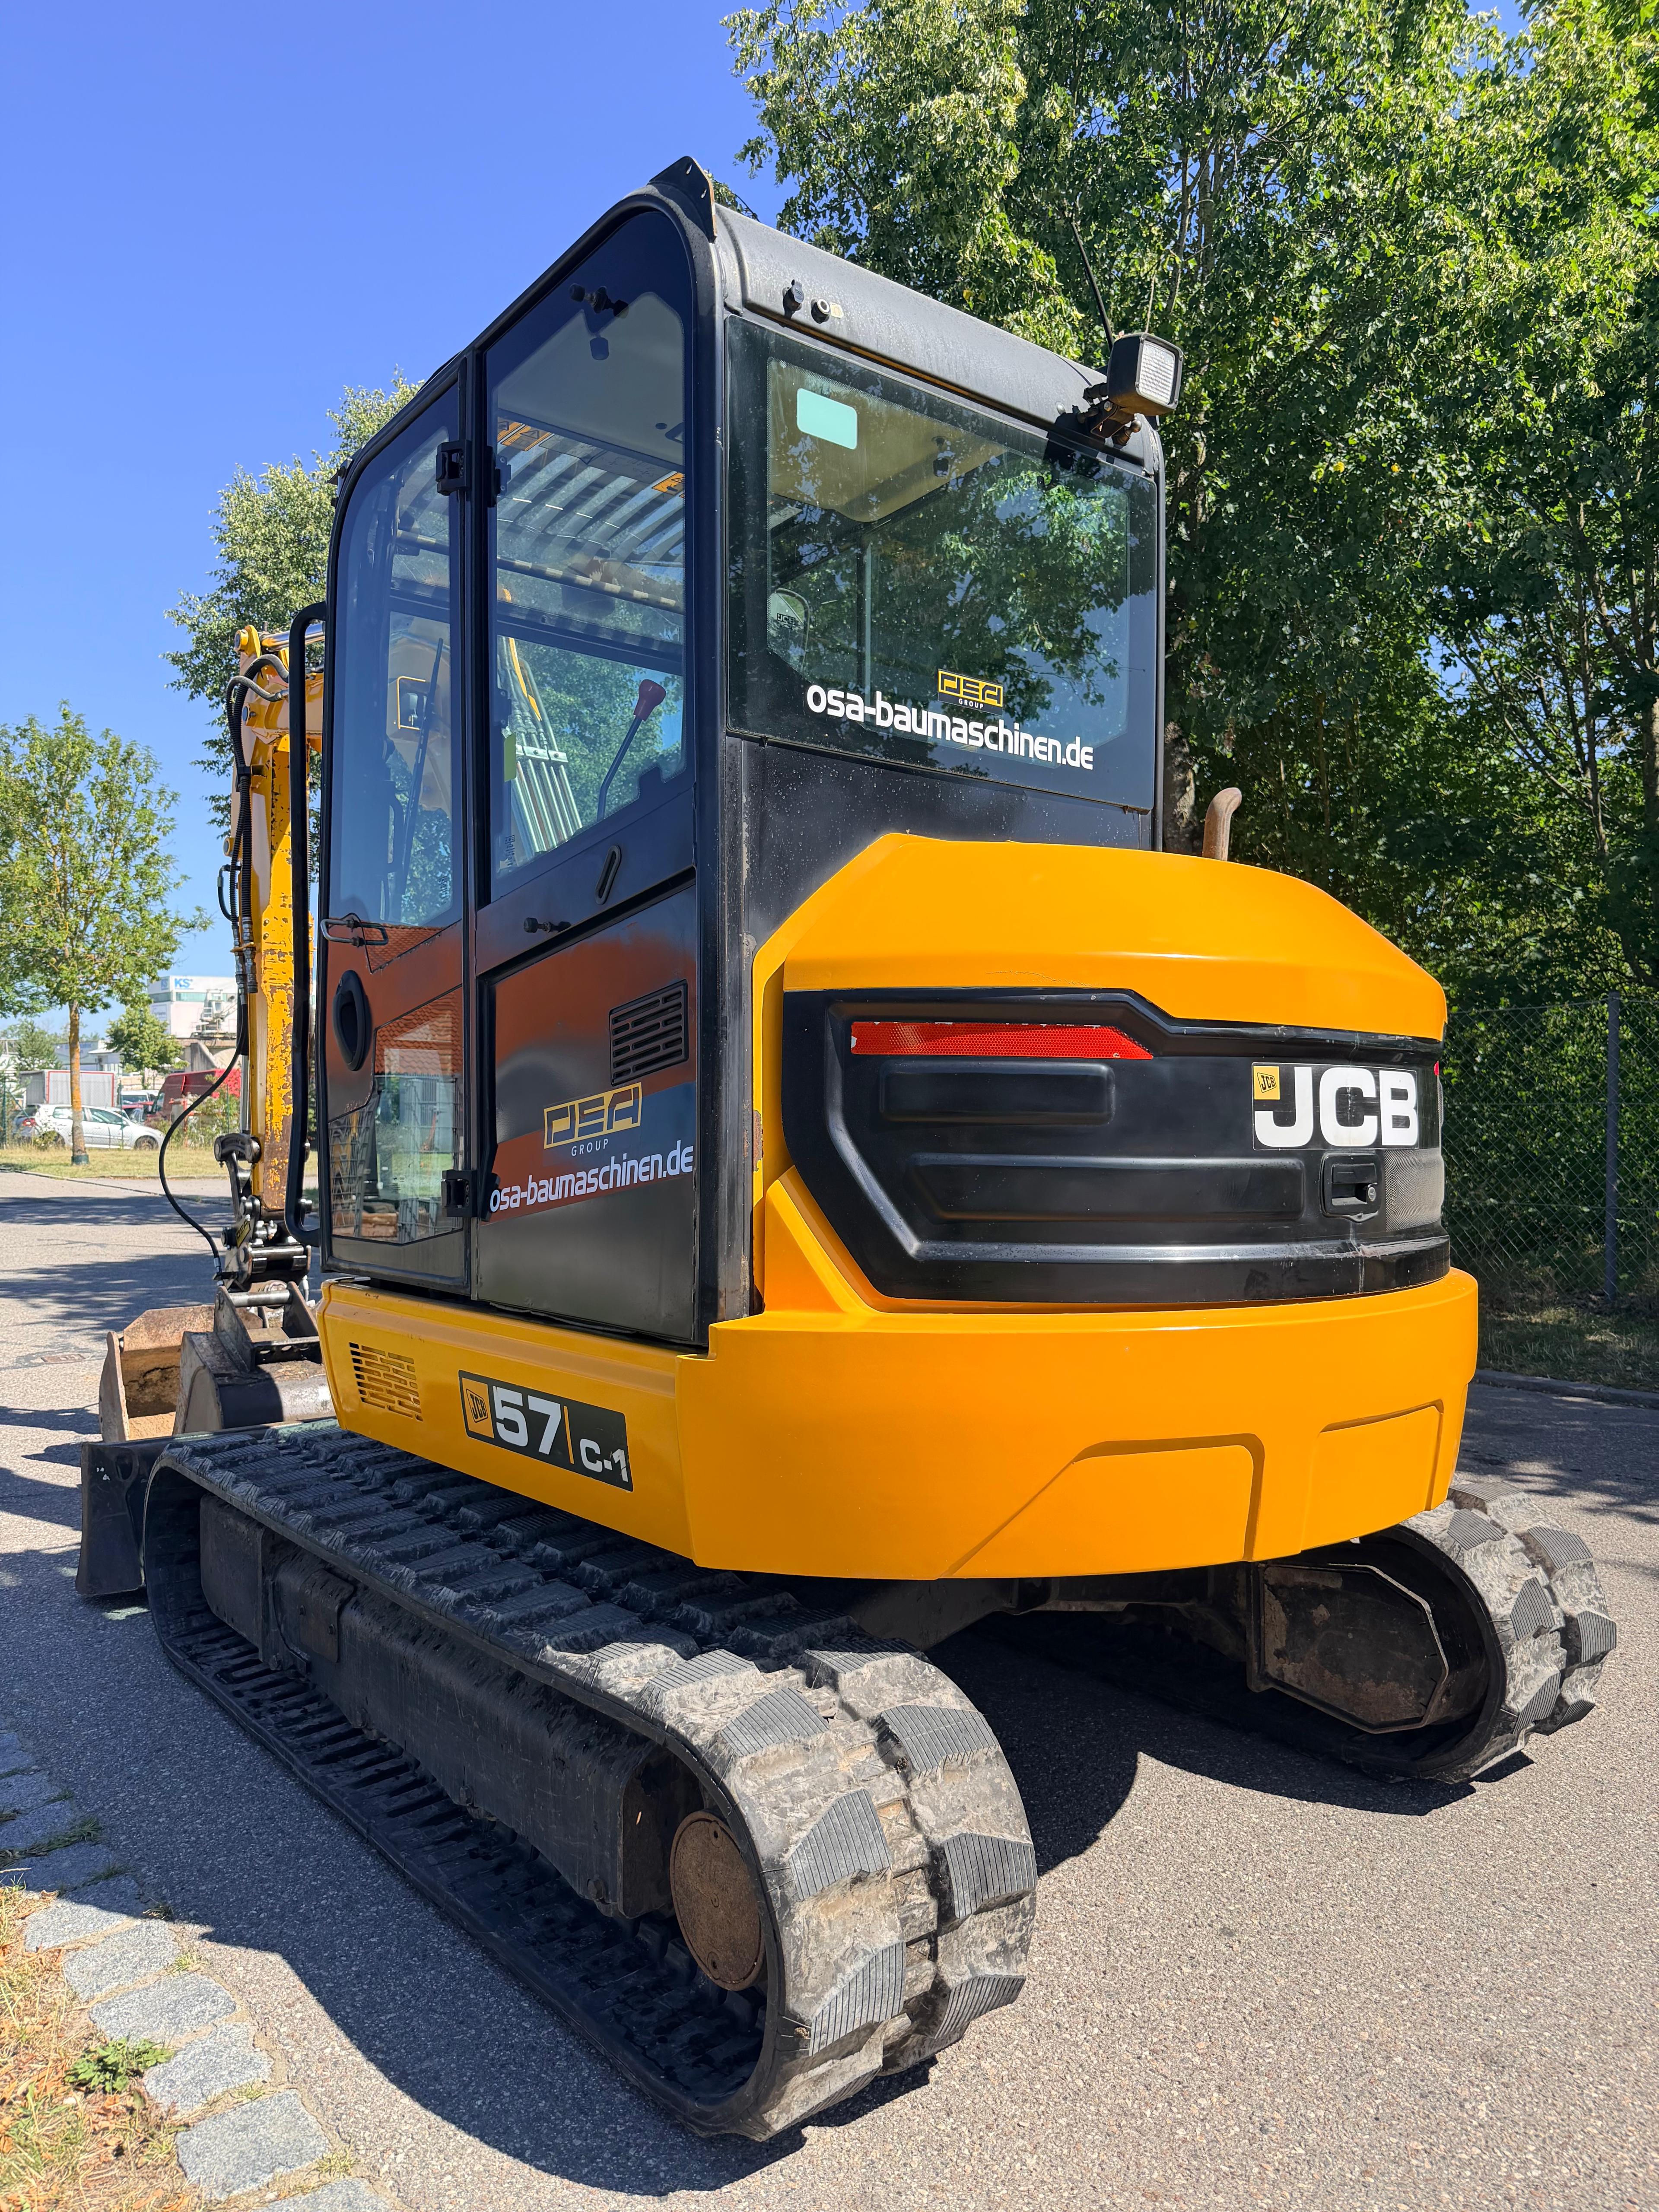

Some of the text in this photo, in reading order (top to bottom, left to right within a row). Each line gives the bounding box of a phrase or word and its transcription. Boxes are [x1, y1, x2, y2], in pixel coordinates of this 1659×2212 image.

[777, 613, 795, 625] JCB
[958, 698, 984, 709] GROUP
[807, 685, 1093, 770] osa-baumaschinen.de
[175, 978, 191, 988] KS
[1260, 1074, 1275, 1090] JCB
[1255, 1067, 1418, 1147] JCB
[571, 1138, 608, 1157] GROUP
[490, 1140, 693, 1213] osa-baumaschinen.de
[469, 1393, 487, 1420] JCB
[493, 1385, 629, 1482] 57 C-1
